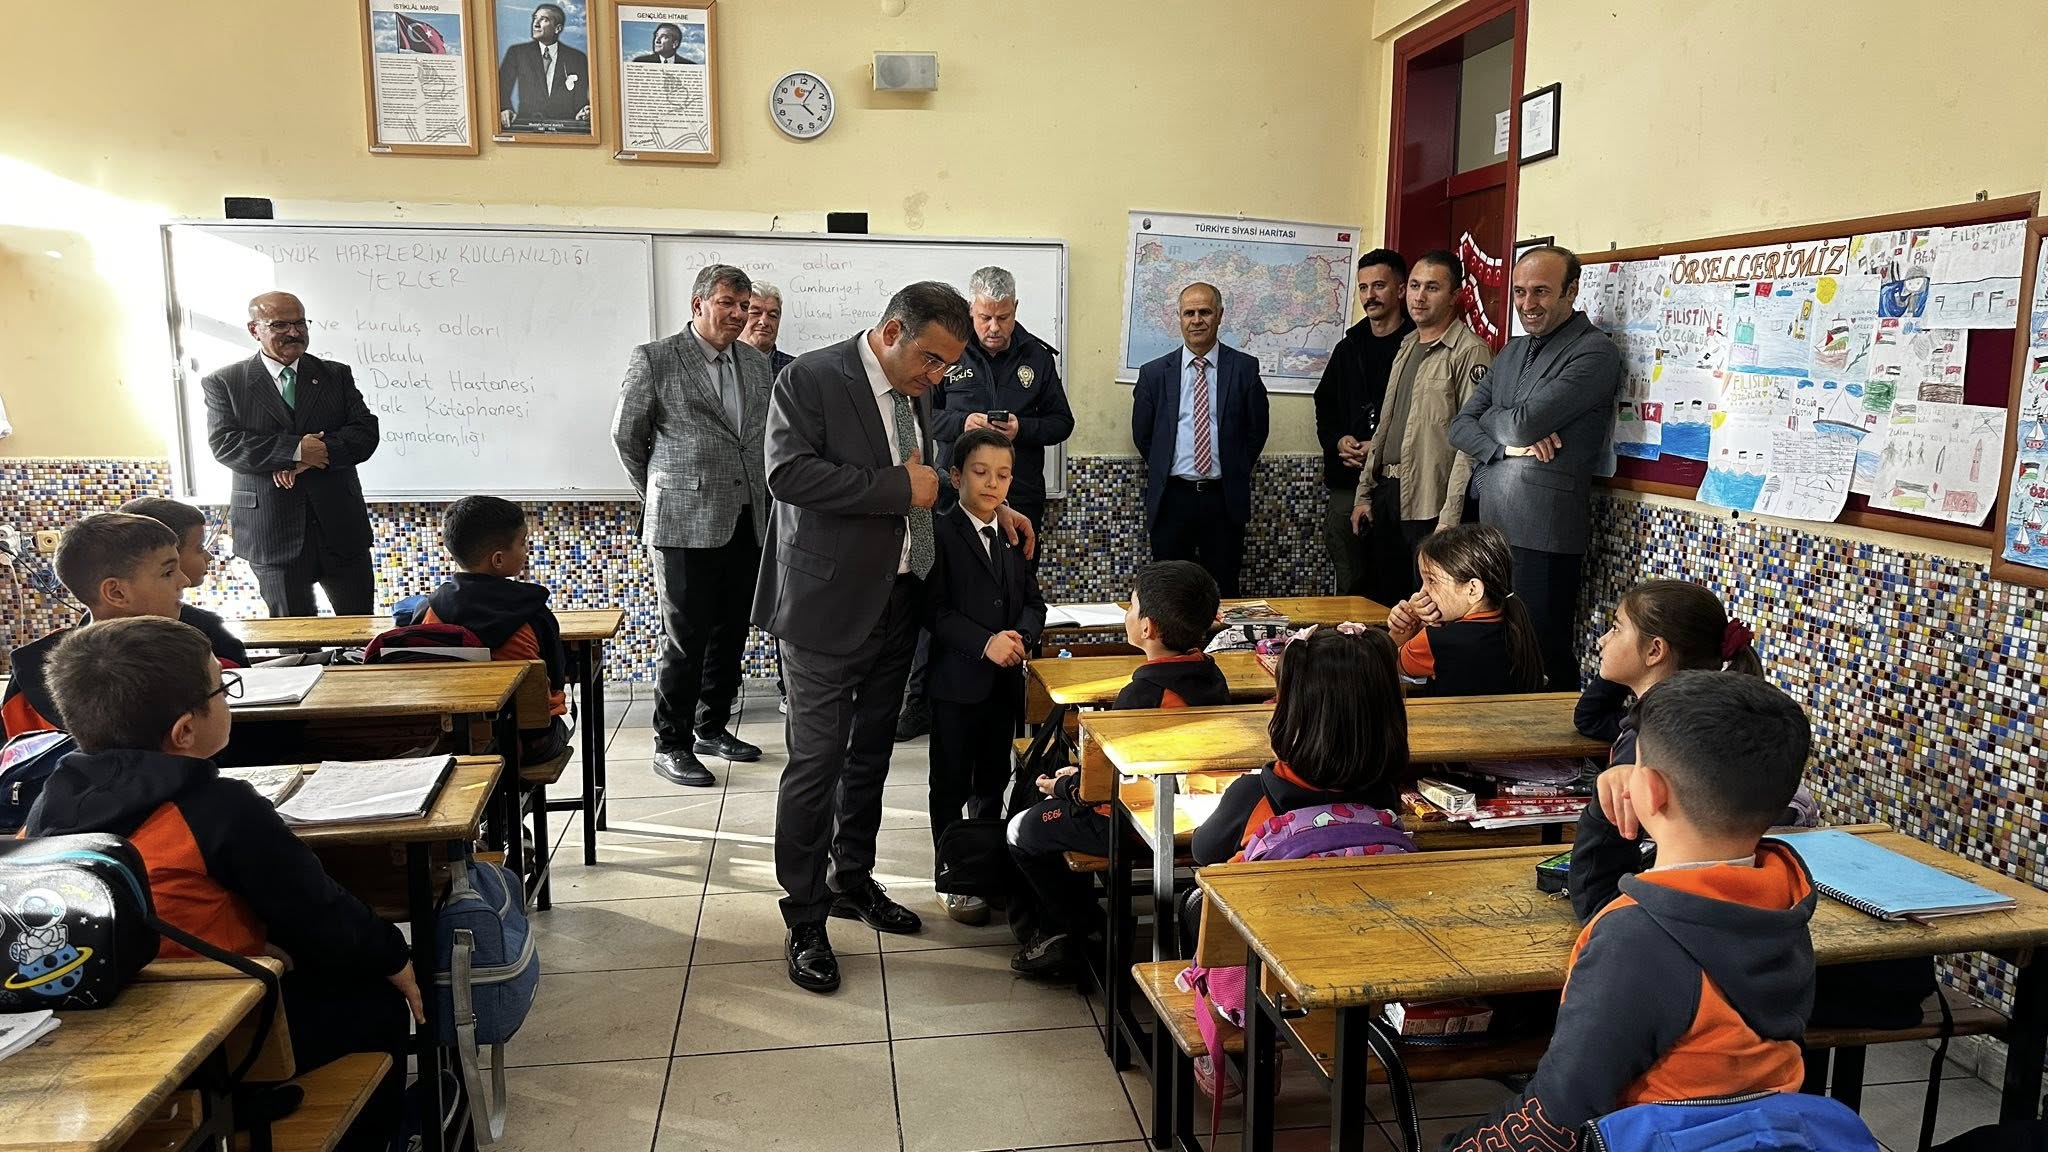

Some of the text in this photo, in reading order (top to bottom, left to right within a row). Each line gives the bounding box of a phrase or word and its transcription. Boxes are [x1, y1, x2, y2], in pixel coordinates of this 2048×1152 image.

[1195, 223, 1296, 239] TÜRKİYE SİYASİ HARİTASI
[336, 243, 447, 263] HARFLERİN
[789, 275, 863, 301] Cumhuriyet
[317, 309, 500, 338] ve kuruluş adları
[354, 338, 425, 365] İlkokulu
[369, 367, 536, 393] Devlet Hastanesi
[367, 393, 530, 426] Halk Kütüphanesi
[381, 423, 485, 457] aymakamlığı
[1042, 808, 1063, 823] 1939
